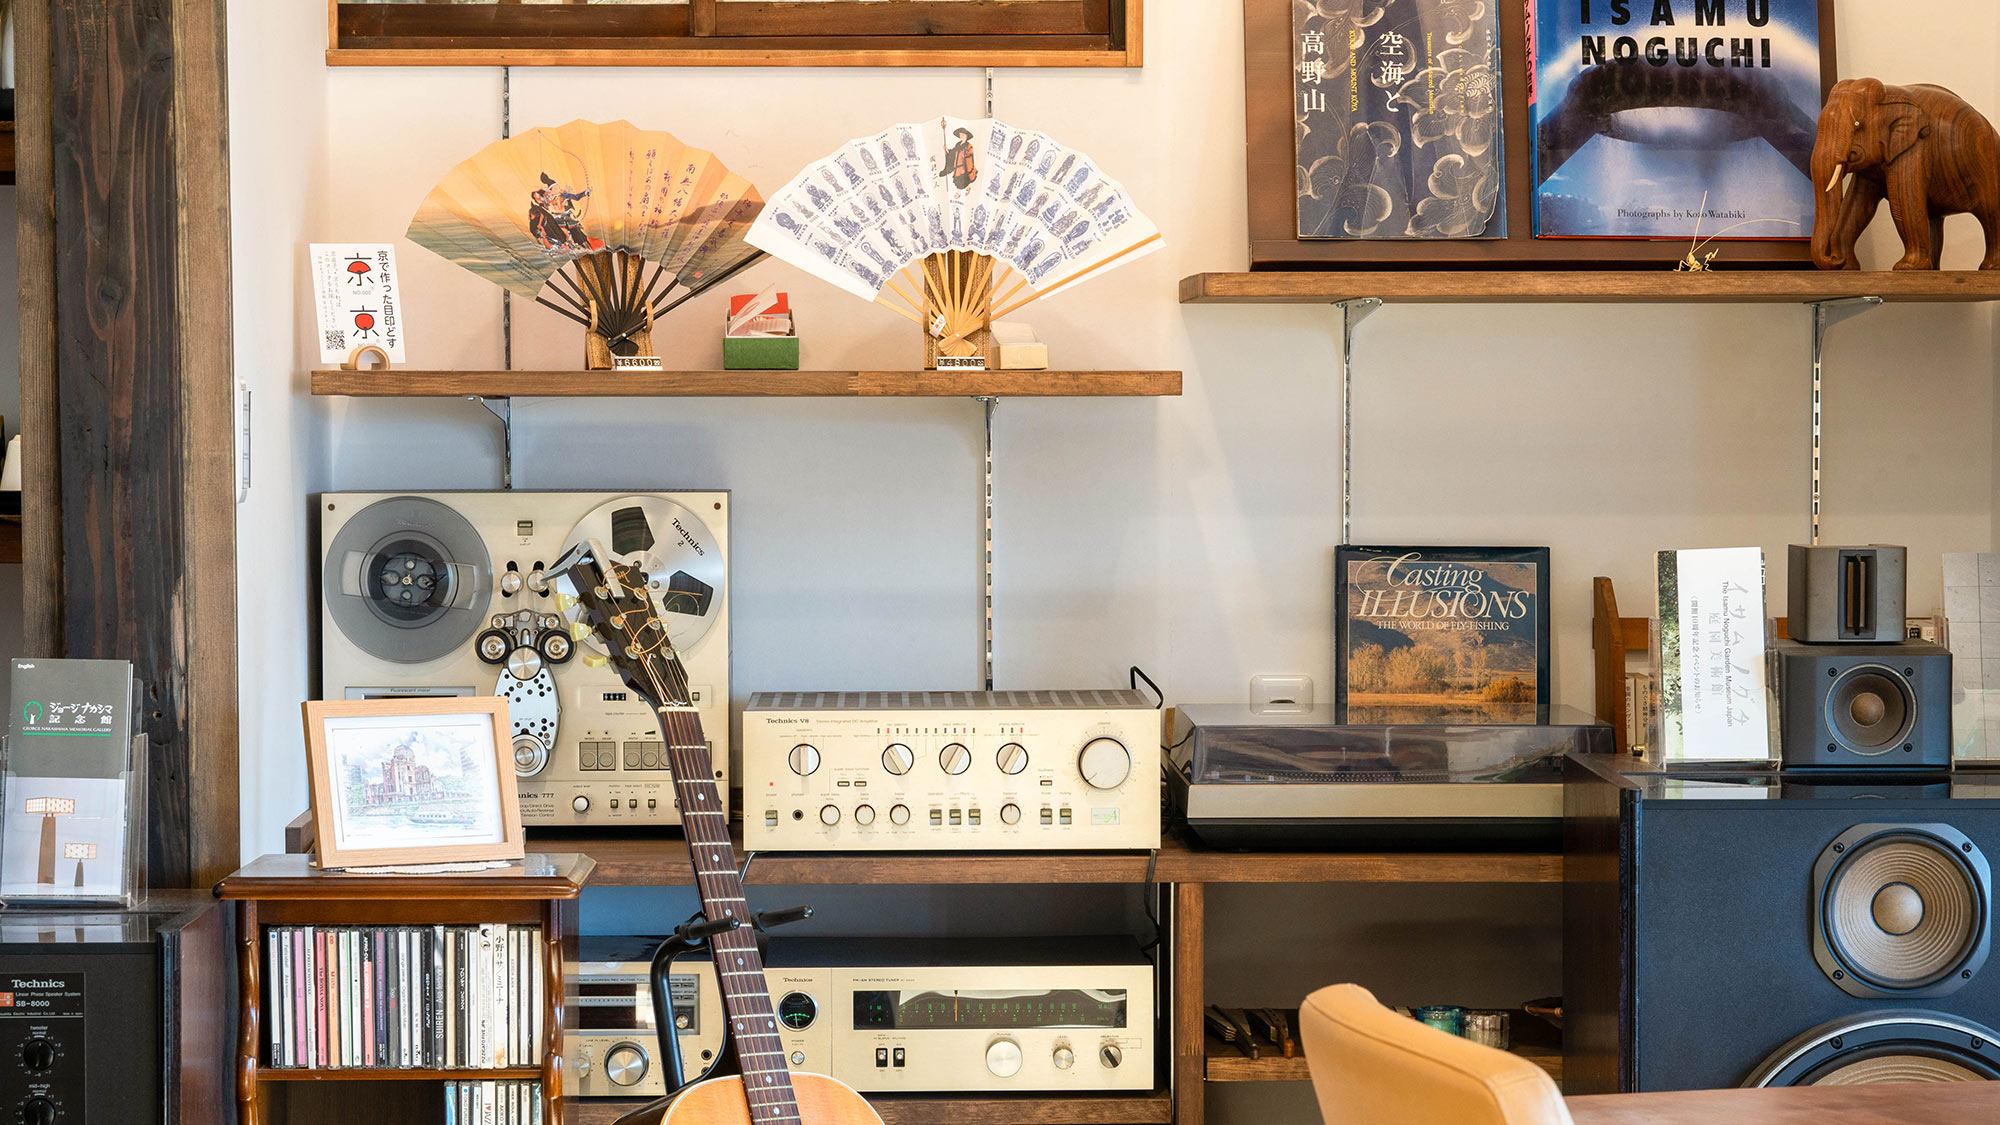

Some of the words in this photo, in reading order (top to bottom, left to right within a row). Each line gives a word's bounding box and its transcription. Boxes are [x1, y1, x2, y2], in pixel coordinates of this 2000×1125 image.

[1581, 0, 1769, 27] ISAMU
[1582, 36, 1771, 68] NOGUCHI
[1301, 31, 1326, 113] 高野山
[1379, 31, 1405, 113] 空海と
[1618, 209, 1670, 220] Photographs
[1674, 209, 1683, 220] by
[1708, 210, 1746, 219] Watabiki
[377, 250, 397, 349] 京で作った目印どす
[671, 517, 705, 556] Technics
[1356, 552, 1484, 595] Casting
[1356, 589, 1530, 618] ILLUSIONS
[1378, 621, 1396, 630] THE
[1399, 621, 1434, 630] WORLD
[1436, 621, 1448, 630] OF
[1450, 621, 1510, 631] FLY-FISHING
[48, 715, 112, 724] 記念館
[11, 979, 65, 988] Technics
